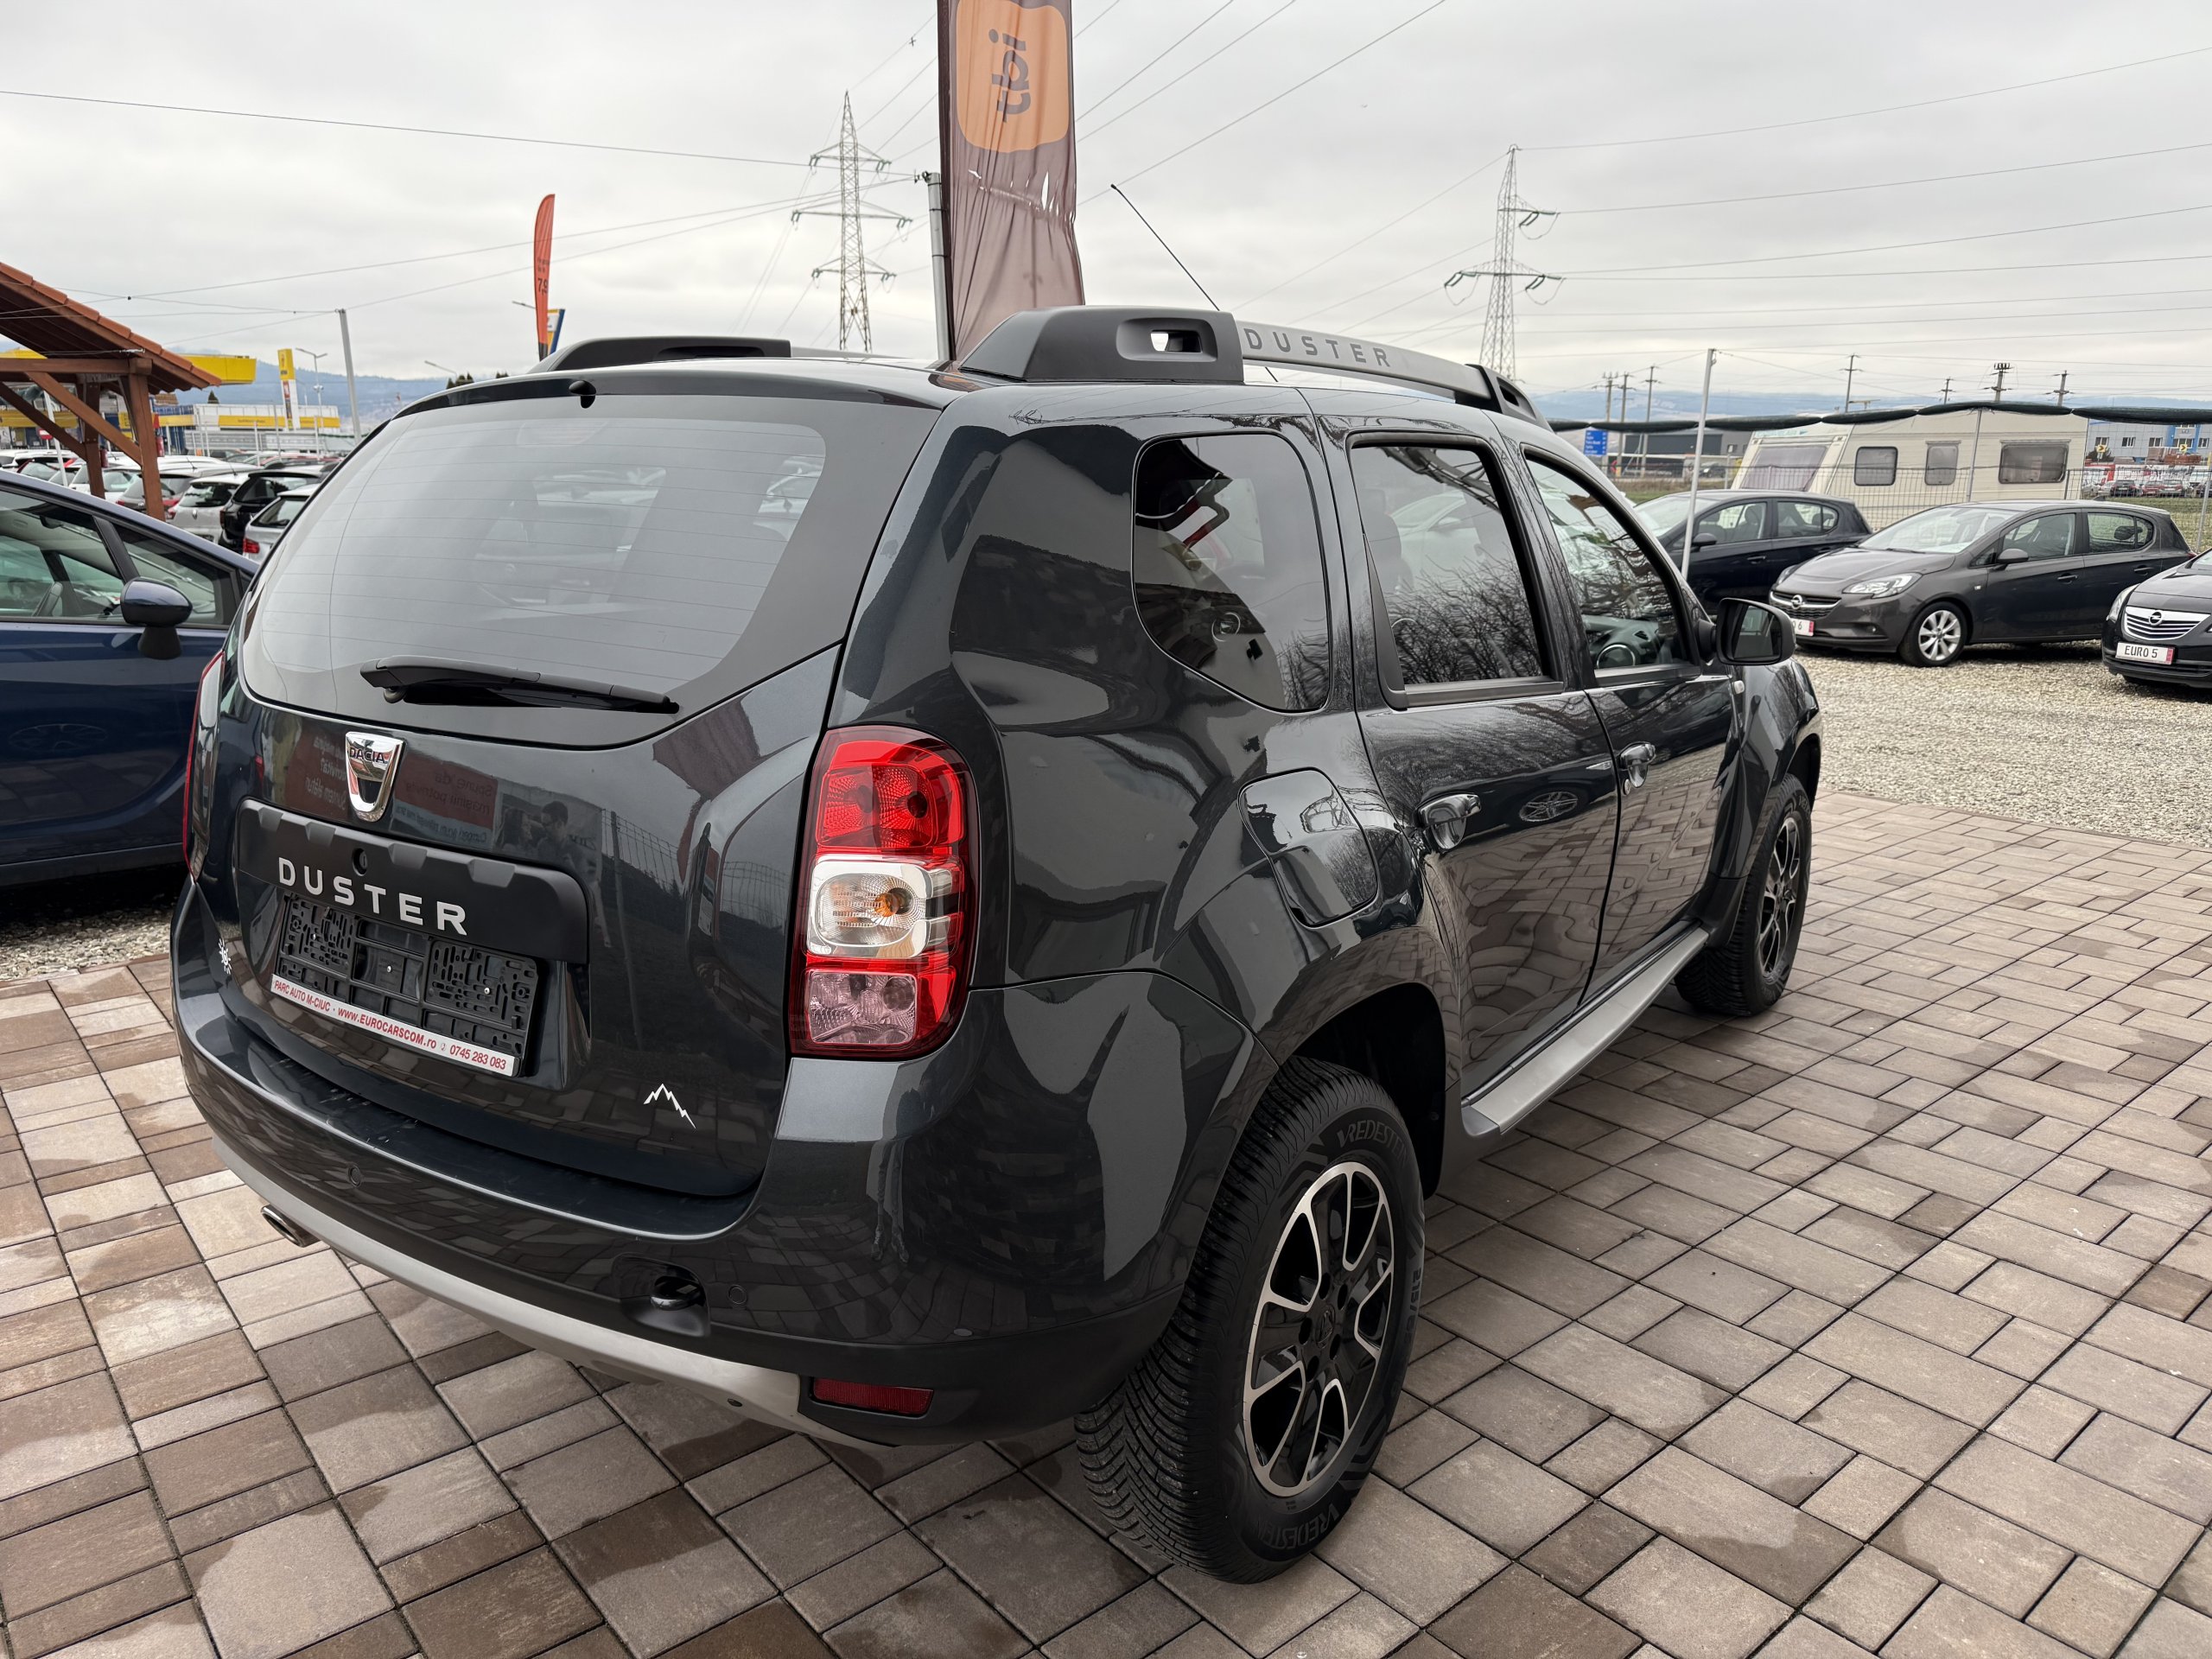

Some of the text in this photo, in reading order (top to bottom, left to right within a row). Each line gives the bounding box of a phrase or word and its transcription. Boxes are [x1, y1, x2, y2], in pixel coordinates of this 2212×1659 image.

[988, 29, 1032, 123] tbi
[1243, 327, 1391, 367] DUSTER
[2125, 645, 2158, 658] EURO 5
[349, 747, 385, 764] DACIA
[278, 856, 467, 936] DUSTER
[274, 980, 506, 1070] PARC AUTO M-CIUC www.EUROCARSCOM.ro 0745 283 083
[1336, 1118, 1410, 1165] VREDESTEIN
